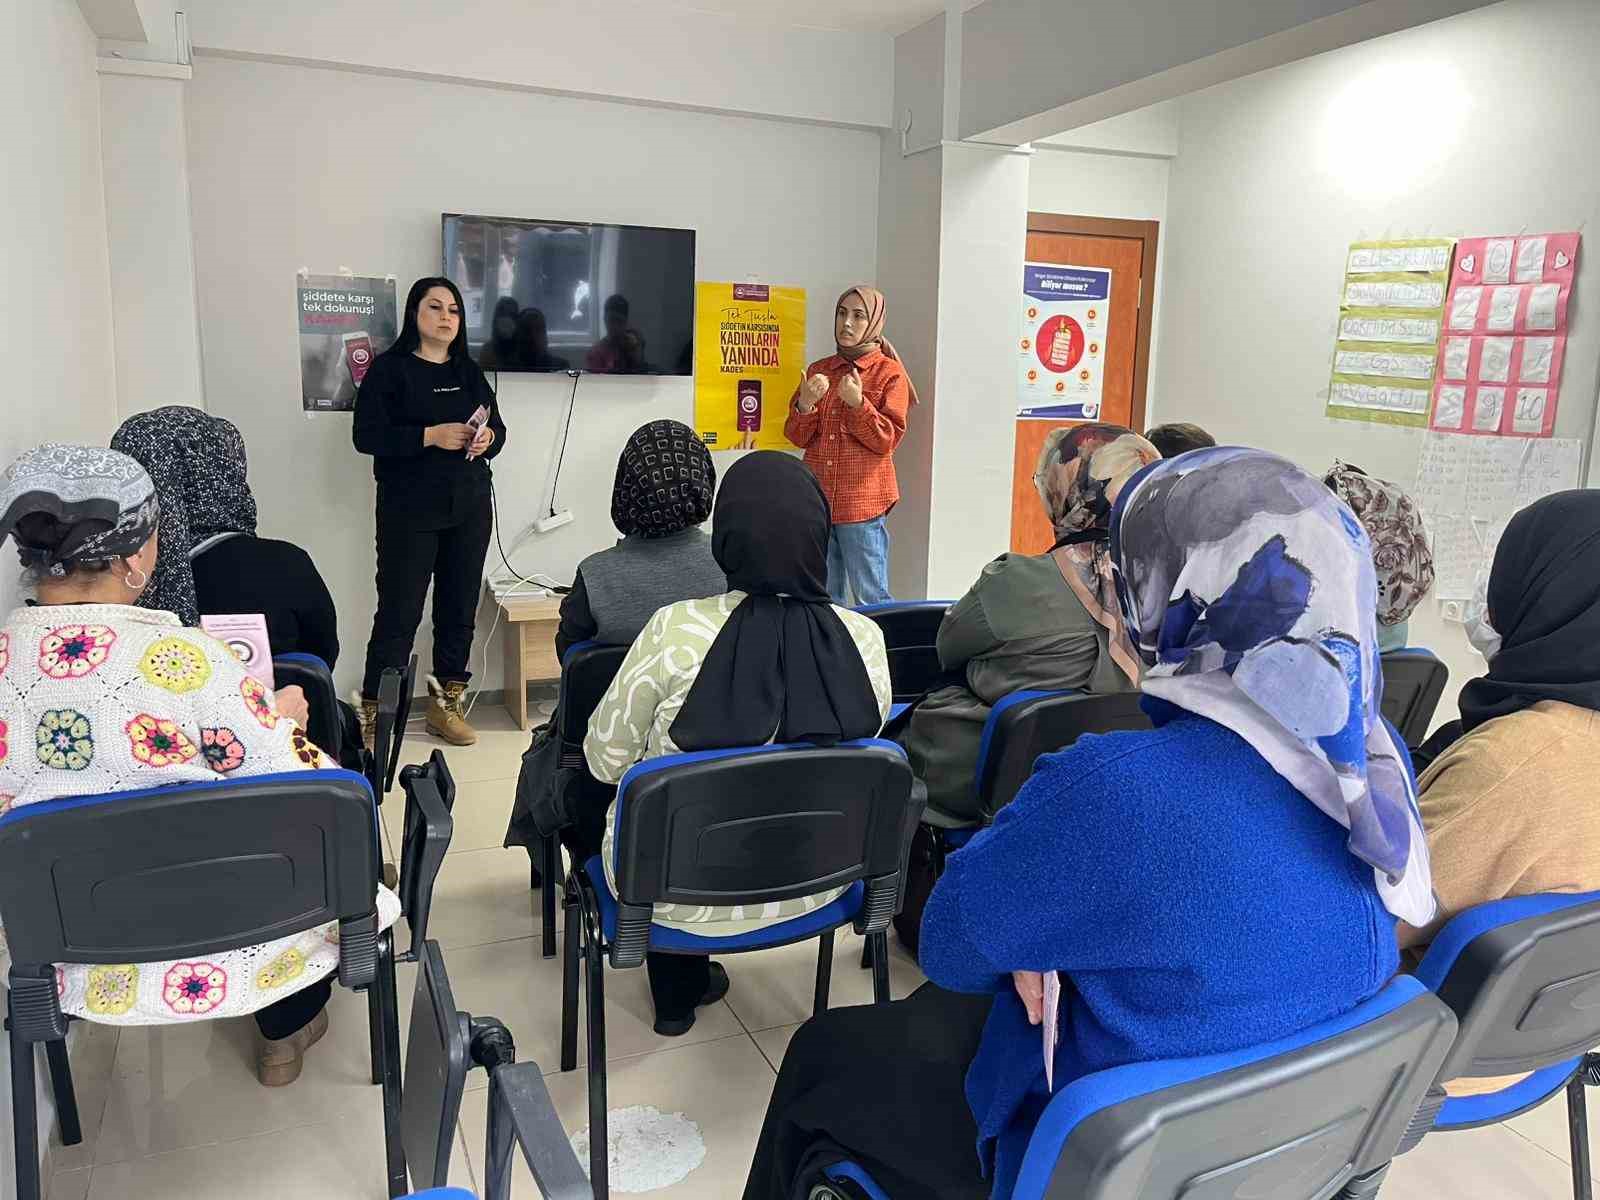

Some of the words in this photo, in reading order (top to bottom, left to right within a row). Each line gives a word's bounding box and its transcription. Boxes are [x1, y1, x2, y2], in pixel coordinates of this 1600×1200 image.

[348, 293, 375, 304] karşı
[303, 302, 321, 312] tek
[324, 303, 375, 315] dokunuş!
[720, 331, 779, 347] KADINLARIN
[720, 346, 779, 367] YANINDA
[1517, 394, 1543, 421] 10
